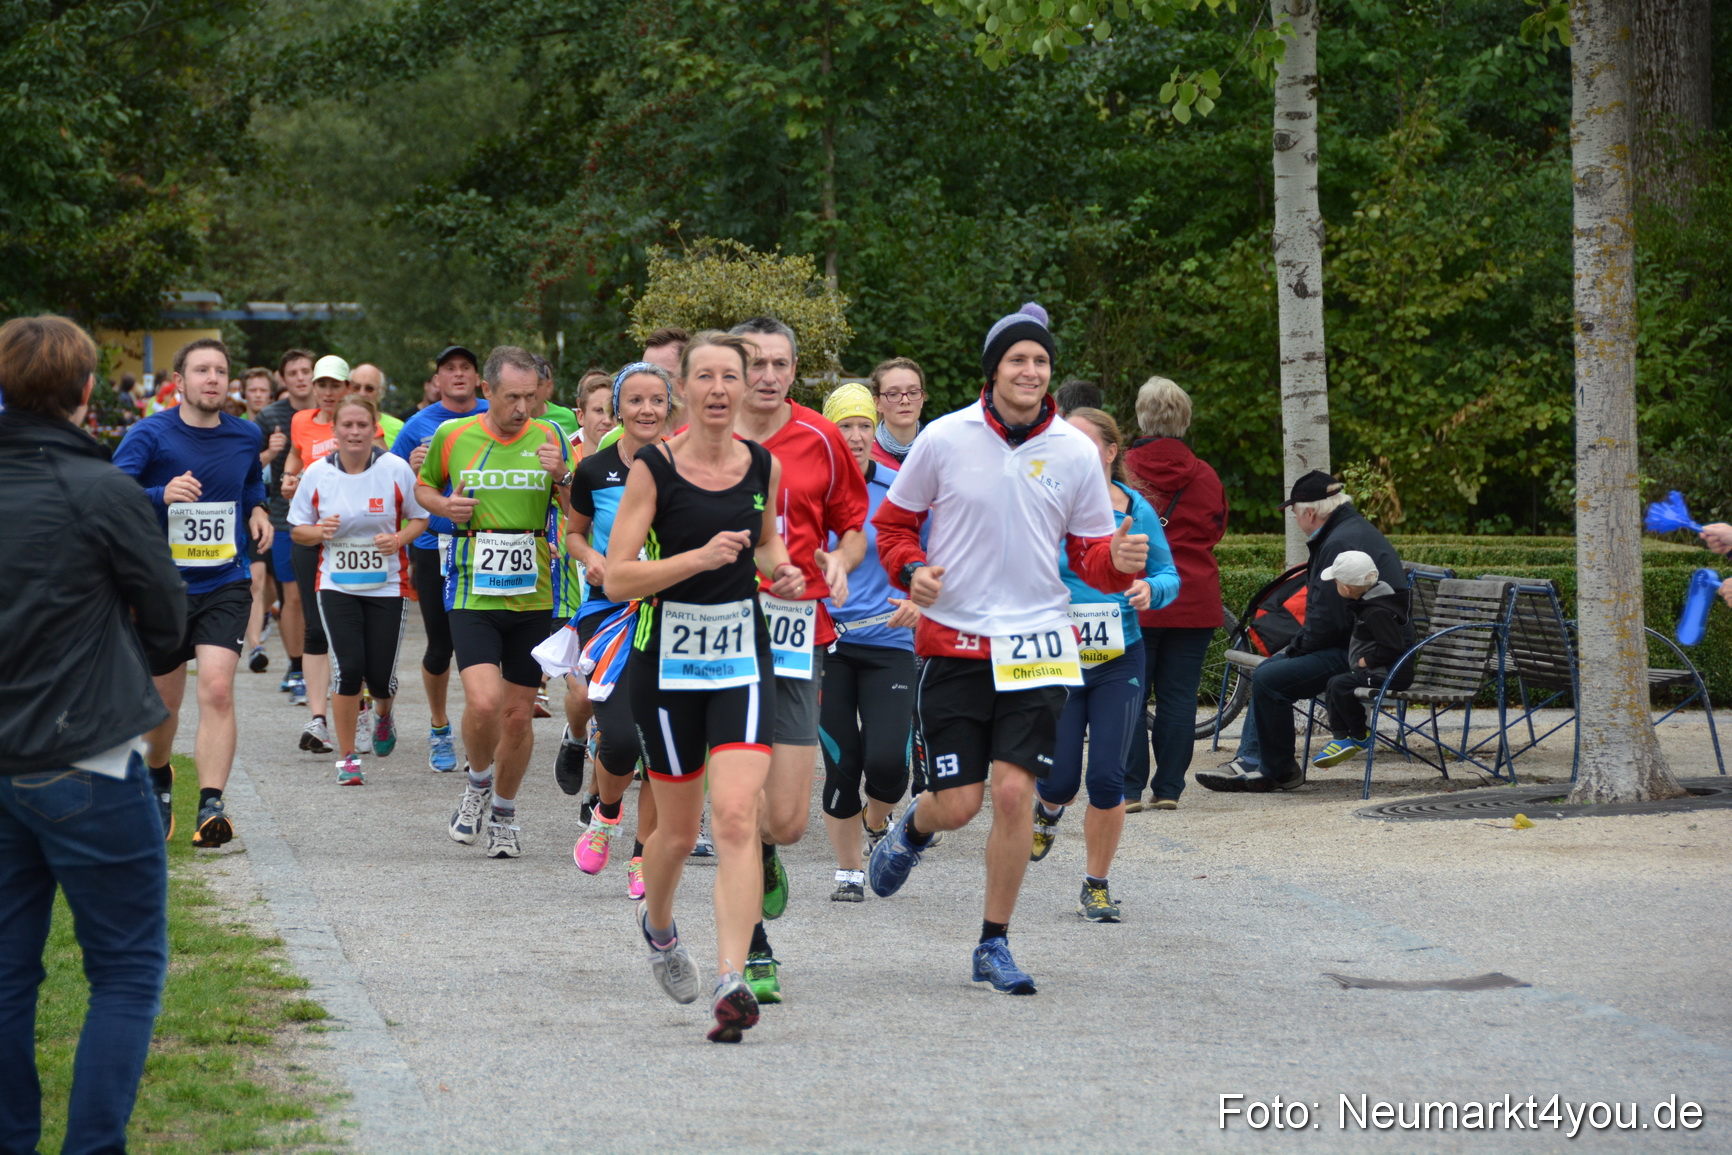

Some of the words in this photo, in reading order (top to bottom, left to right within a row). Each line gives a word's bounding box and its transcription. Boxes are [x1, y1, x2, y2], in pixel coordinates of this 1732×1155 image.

[460, 469, 547, 491] BOCK
[1040, 475, 1060, 491] I.S.T.
[196, 508, 227, 516] Neumarkt
[183, 518, 225, 542] 356
[478, 537, 499, 546] PARTL
[500, 538, 528, 547] Neumarkt
[187, 548, 219, 558] Markus
[336, 550, 383, 570] 3035
[481, 548, 533, 572] 2793
[489, 577, 523, 587] Helmuth
[764, 601, 803, 614] Neumarkt
[1072, 610, 1109, 618] Neumarkt
[665, 610, 697, 621] PARTL
[700, 611, 740, 622] Neumarkt
[672, 622, 743, 655] 2141
[954, 632, 980, 651] 53
[1009, 630, 1063, 660] 210
[682, 663, 735, 677] Manuela
[1012, 666, 1063, 680] Christian
[935, 753, 960, 778] 53
